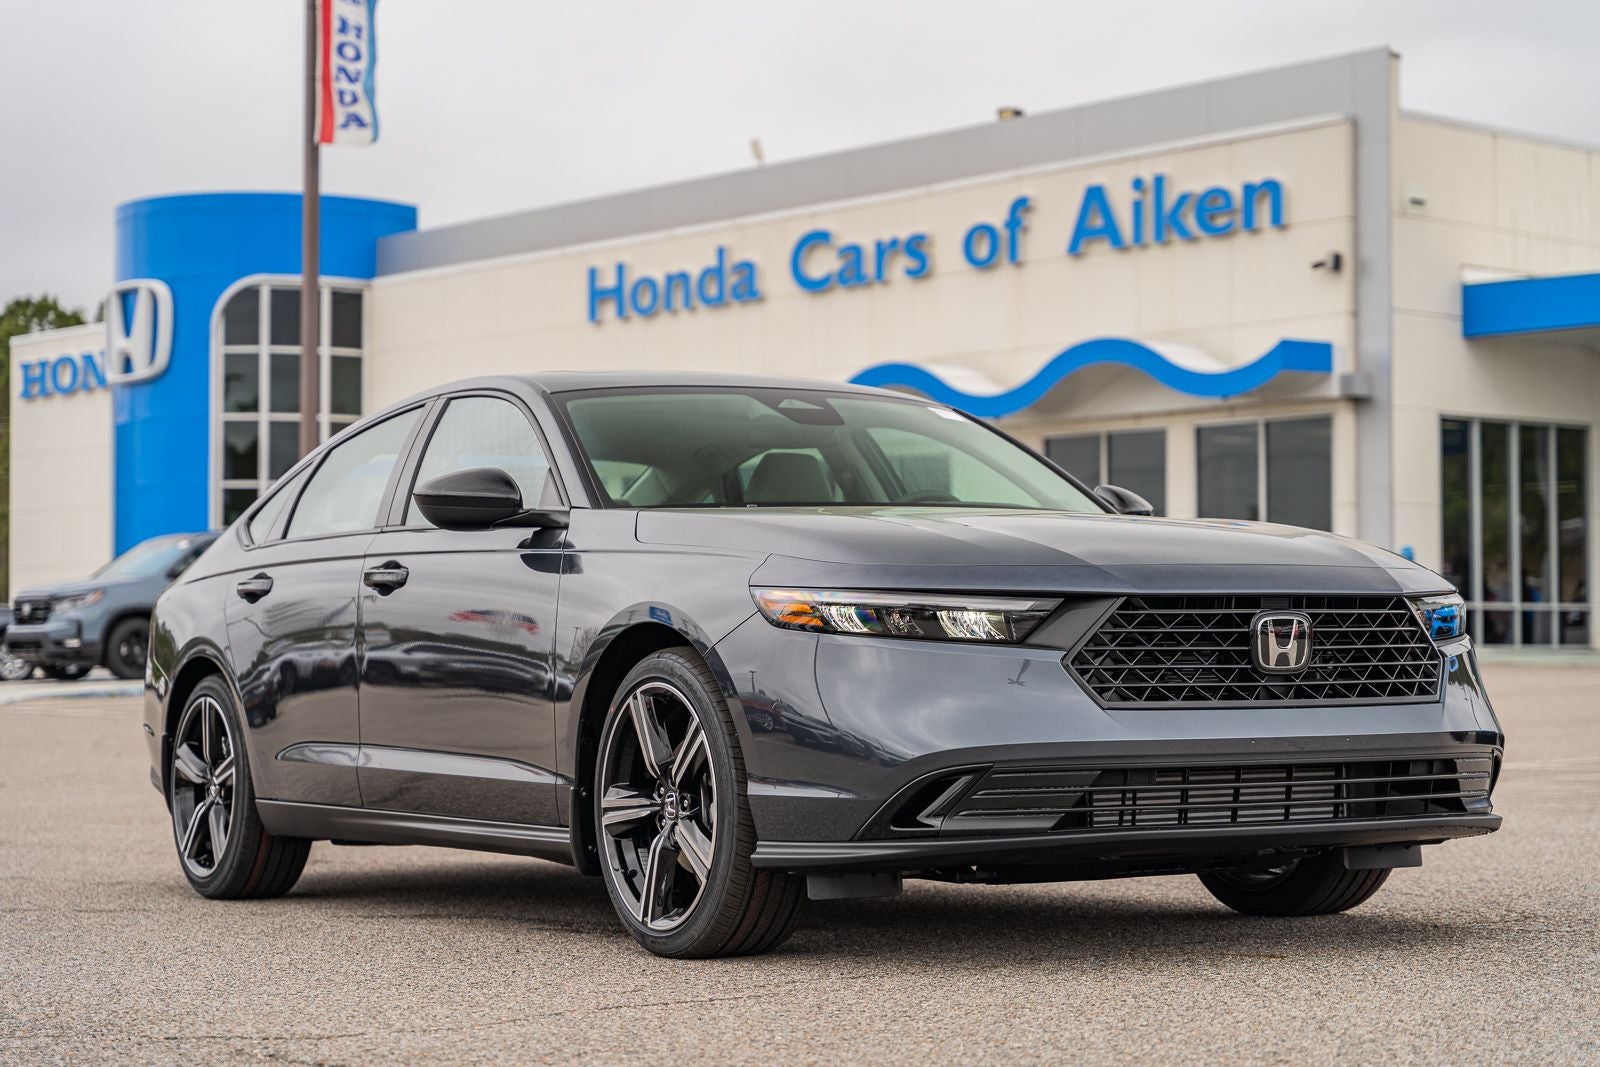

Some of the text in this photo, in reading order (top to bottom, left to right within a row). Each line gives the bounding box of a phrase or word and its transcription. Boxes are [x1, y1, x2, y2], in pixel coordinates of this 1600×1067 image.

[586, 174, 1285, 323] Honda Cars of Aiken
